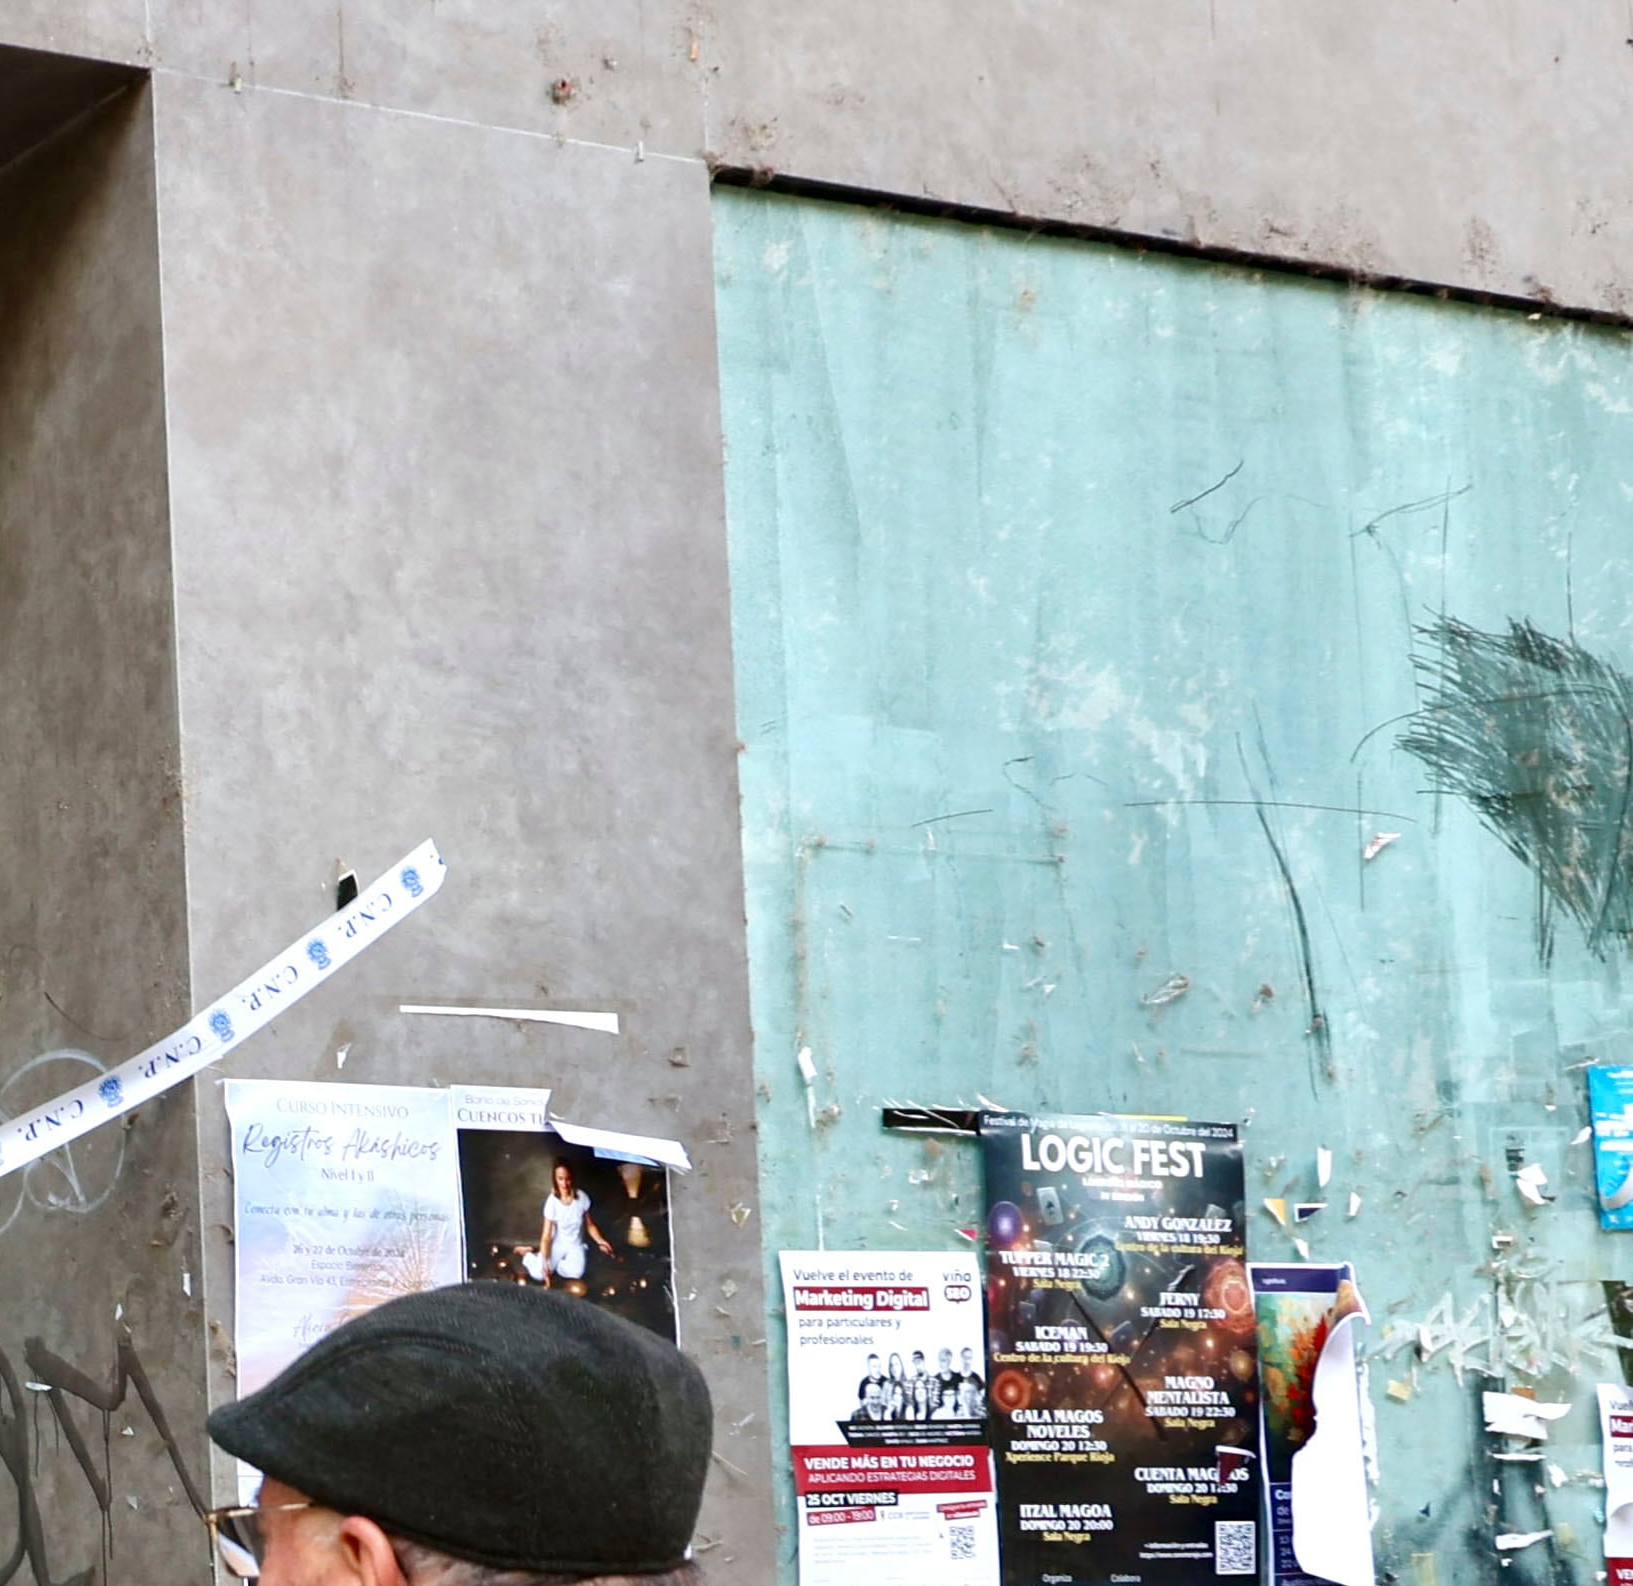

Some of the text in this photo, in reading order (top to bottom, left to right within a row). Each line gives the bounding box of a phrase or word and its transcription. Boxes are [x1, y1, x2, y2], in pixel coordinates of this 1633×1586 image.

[337, 893, 392, 939] C.N.P.
[237, 965, 298, 1011] C.N.P.
[143, 1037, 201, 1078] C.N.P.
[277, 1098, 409, 1121] CURSO INTENSIVO
[25, 1098, 85, 1141] C.N.P.
[243, 1123, 334, 1168] Registros
[1021, 1133, 1206, 1177] LOGIC FEST
[793, 1269, 913, 1282] Vuelve el evento de
[795, 1288, 929, 1310] Marketing Digital
[946, 1286, 970, 1299] SEO
[799, 1316, 902, 1330] para particulares y
[799, 1333, 874, 1347] profesionales
[1034, 1326, 1089, 1341] ICEMAN
[1146, 1391, 1230, 1405] MENTALISTA
[1011, 1410, 1104, 1424] GALA MAGOS
[1026, 1425, 1091, 1439] NOVELES
[803, 1454, 975, 1470] VENDE MÁS EN TU NEGOCIO
[808, 1470, 976, 1484] APLICANDO ESTRATEGIAS DIGITALES
[1134, 1468, 1186, 1482] CUENTA
[807, 1493, 896, 1506] 25 OCT VIERNES
